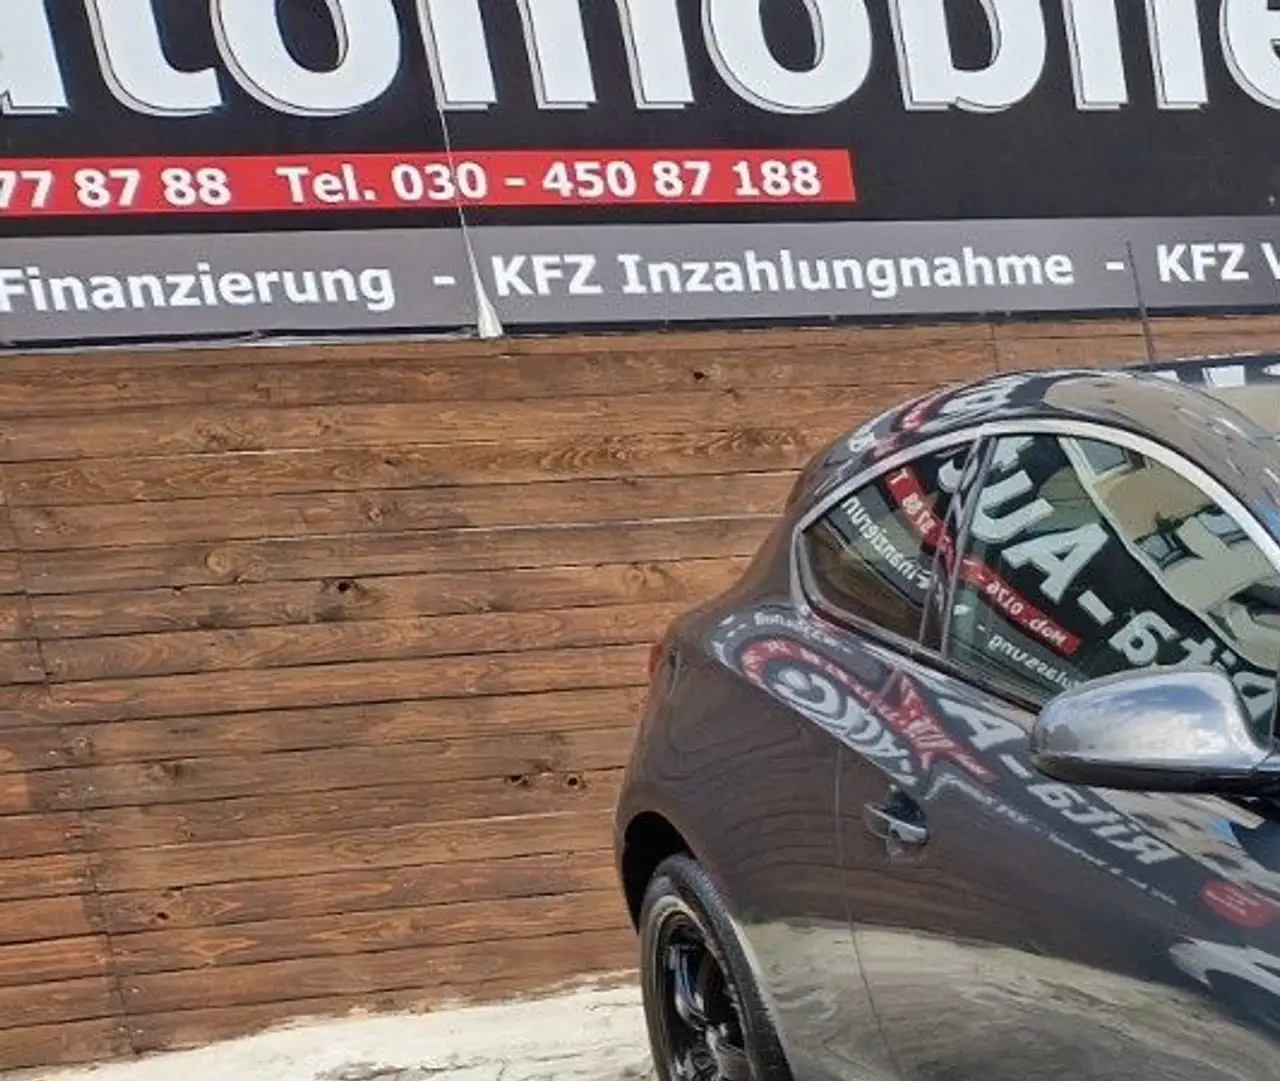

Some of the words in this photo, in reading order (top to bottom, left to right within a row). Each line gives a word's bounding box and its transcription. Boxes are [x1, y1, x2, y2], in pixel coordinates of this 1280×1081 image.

[74, 167, 141, 208] 87
[160, 166, 232, 207] 88
[275, 163, 377, 203] Tel.
[391, 161, 488, 201] 030
[504, 177, 527, 188] -
[541, 160, 637, 199] 450
[652, 160, 712, 198] 87
[732, 159, 823, 198] 188
[0, 261, 396, 312] Finanzierung
[490, 253, 605, 297] KFZ
[616, 246, 1075, 300] Inzahlungnahme
[1156, 242, 1250, 283] KFZ
